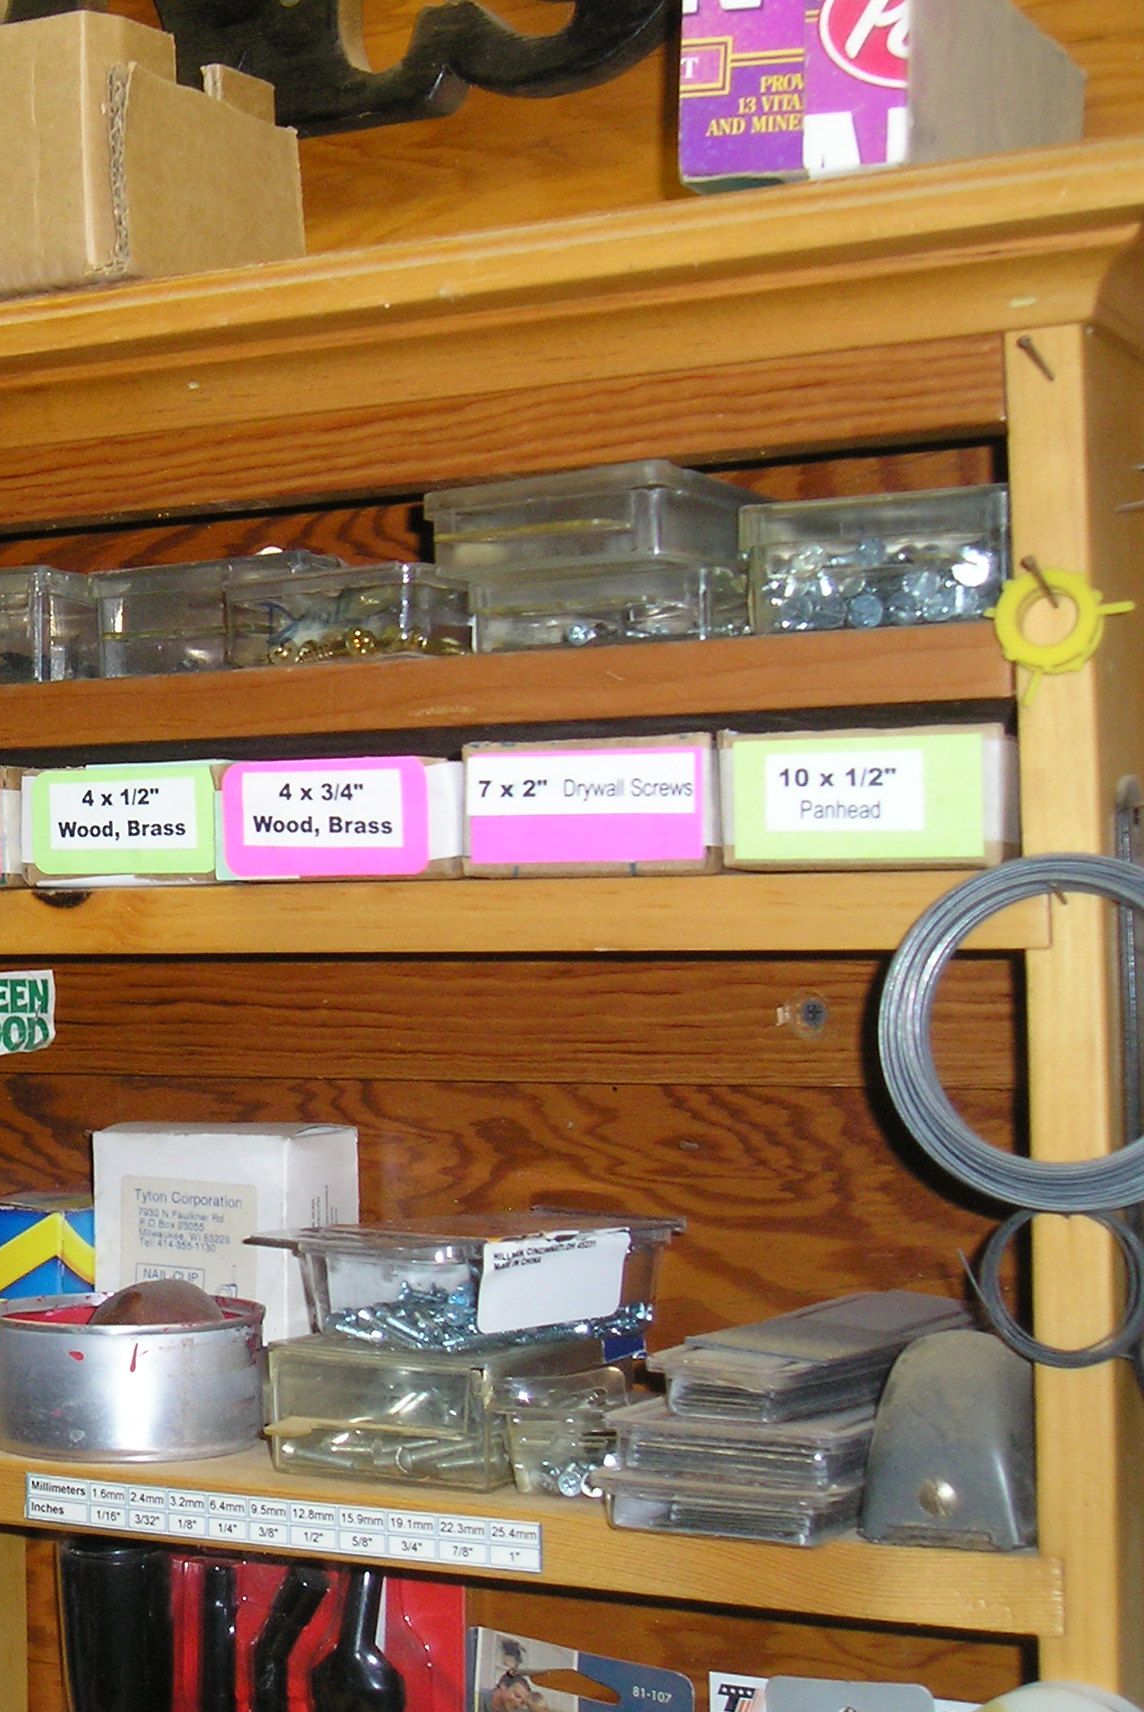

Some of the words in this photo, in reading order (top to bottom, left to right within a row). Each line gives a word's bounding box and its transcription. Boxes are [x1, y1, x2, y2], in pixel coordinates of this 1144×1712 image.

[738, 96, 757, 114] 13
[705, 116, 746, 137] AND
[751, 113, 803, 133] MINE
[779, 768, 810, 788] 10
[820, 773, 834, 787] x
[846, 767, 897, 787] 1/2"
[82, 790, 94, 806] 4
[101, 794, 112, 806] x
[121, 788, 159, 805] 1/2"
[279, 783, 291, 800] 4
[301, 788, 313, 800] x
[322, 783, 364, 801] 3/4"
[478, 781, 490, 798] 7
[500, 785, 514, 798] x
[523, 779, 548, 798] 2"
[563, 779, 624, 801] Drywall
[631, 778, 693, 798] Screws
[801, 800, 881, 819] Panhead
[59, 821, 120, 841] Wood,
[128, 820, 186, 838] Brass
[254, 816, 320, 835] Wood,
[329, 816, 393, 834] Brass
[134, 1188, 167, 1204] Tyton
[171, 1190, 243, 1208] Corporation
[143, 1268, 167, 1280] NAIL
[31, 1480, 86, 1497] Millimeters
[92, 1488, 125, 1502] 1.6mm
[130, 1491, 164, 1506] 2.4mm
[170, 1496, 205, 1509] 3.2mm
[209, 1499, 245, 1514] 6.4mm
[251, 1503, 287, 1518] 9.5mm
[293, 1508, 335, 1523] 12.8mm
[342, 1513, 384, 1528] 15.9mm
[391, 1517, 433, 1532] 19.1mm
[440, 1521, 485, 1537] 22.3mm
[492, 1526, 537, 1541] 25.4mm
[31, 1501, 64, 1515] Inches
[97, 1510, 121, 1523] 1/16"
[134, 1513, 160, 1527] 3/32"
[178, 1519, 197, 1531] 1/8"
[218, 1522, 237, 1534] 1/4"
[258, 1526, 278, 1538] 3/8"
[303, 1531, 324, 1543] 1/2"
[352, 1536, 373, 1549] 5/8"
[402, 1540, 422, 1553] 3/4"
[452, 1545, 474, 1558] 7/8"
[509, 1551, 520, 1562] 1"
[632, 1686, 672, 1704] 81-107
